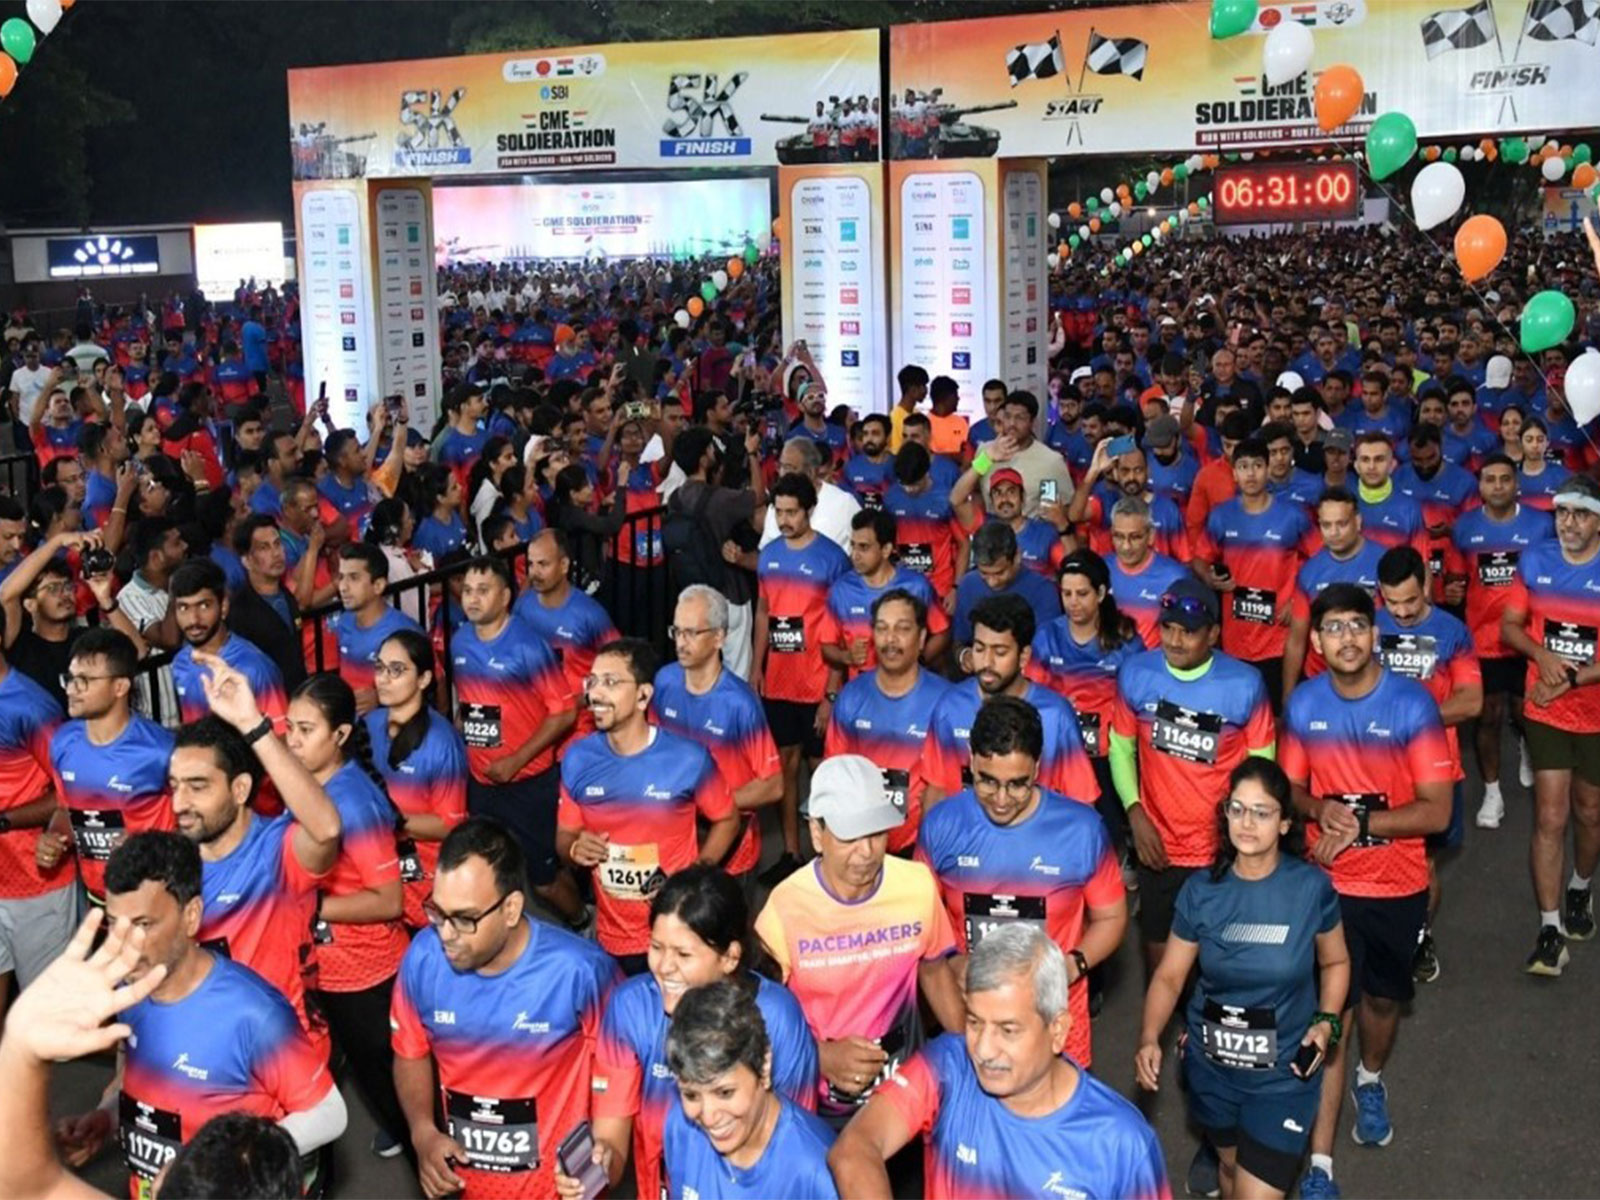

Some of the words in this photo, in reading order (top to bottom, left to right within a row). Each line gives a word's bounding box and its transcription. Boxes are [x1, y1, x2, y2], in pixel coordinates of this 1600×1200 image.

[1469, 65, 1551, 90] FINISH
[550, 85, 569, 100] SBI
[662, 71, 749, 139] 5K
[1045, 98, 1104, 116] START
[1195, 92, 1377, 125] SOLDIERAN
[397, 87, 467, 152] 5K
[540, 110, 570, 131] CME
[496, 128, 615, 152] SOLDIERATHON
[1220, 130, 1241, 142] WITH
[1242, 128, 1283, 141] SOLDIERS
[1291, 126, 1308, 138] RUN
[674, 141, 737, 155] FINISH
[1220, 173, 1351, 208] 06:31:00
[543, 217, 564, 227] CME
[567, 215, 643, 227] SOLDIERATHON
[1241, 601, 1272, 616] 11198
[773, 631, 802, 643] 11904
[1550, 638, 1595, 657] 12244
[463, 721, 499, 737] 10226
[1163, 726, 1214, 752] 11640
[797, 921, 923, 955] PACEMAKERS
[1213, 1029, 1270, 1054] 11712
[461, 1126, 531, 1154] 11762
